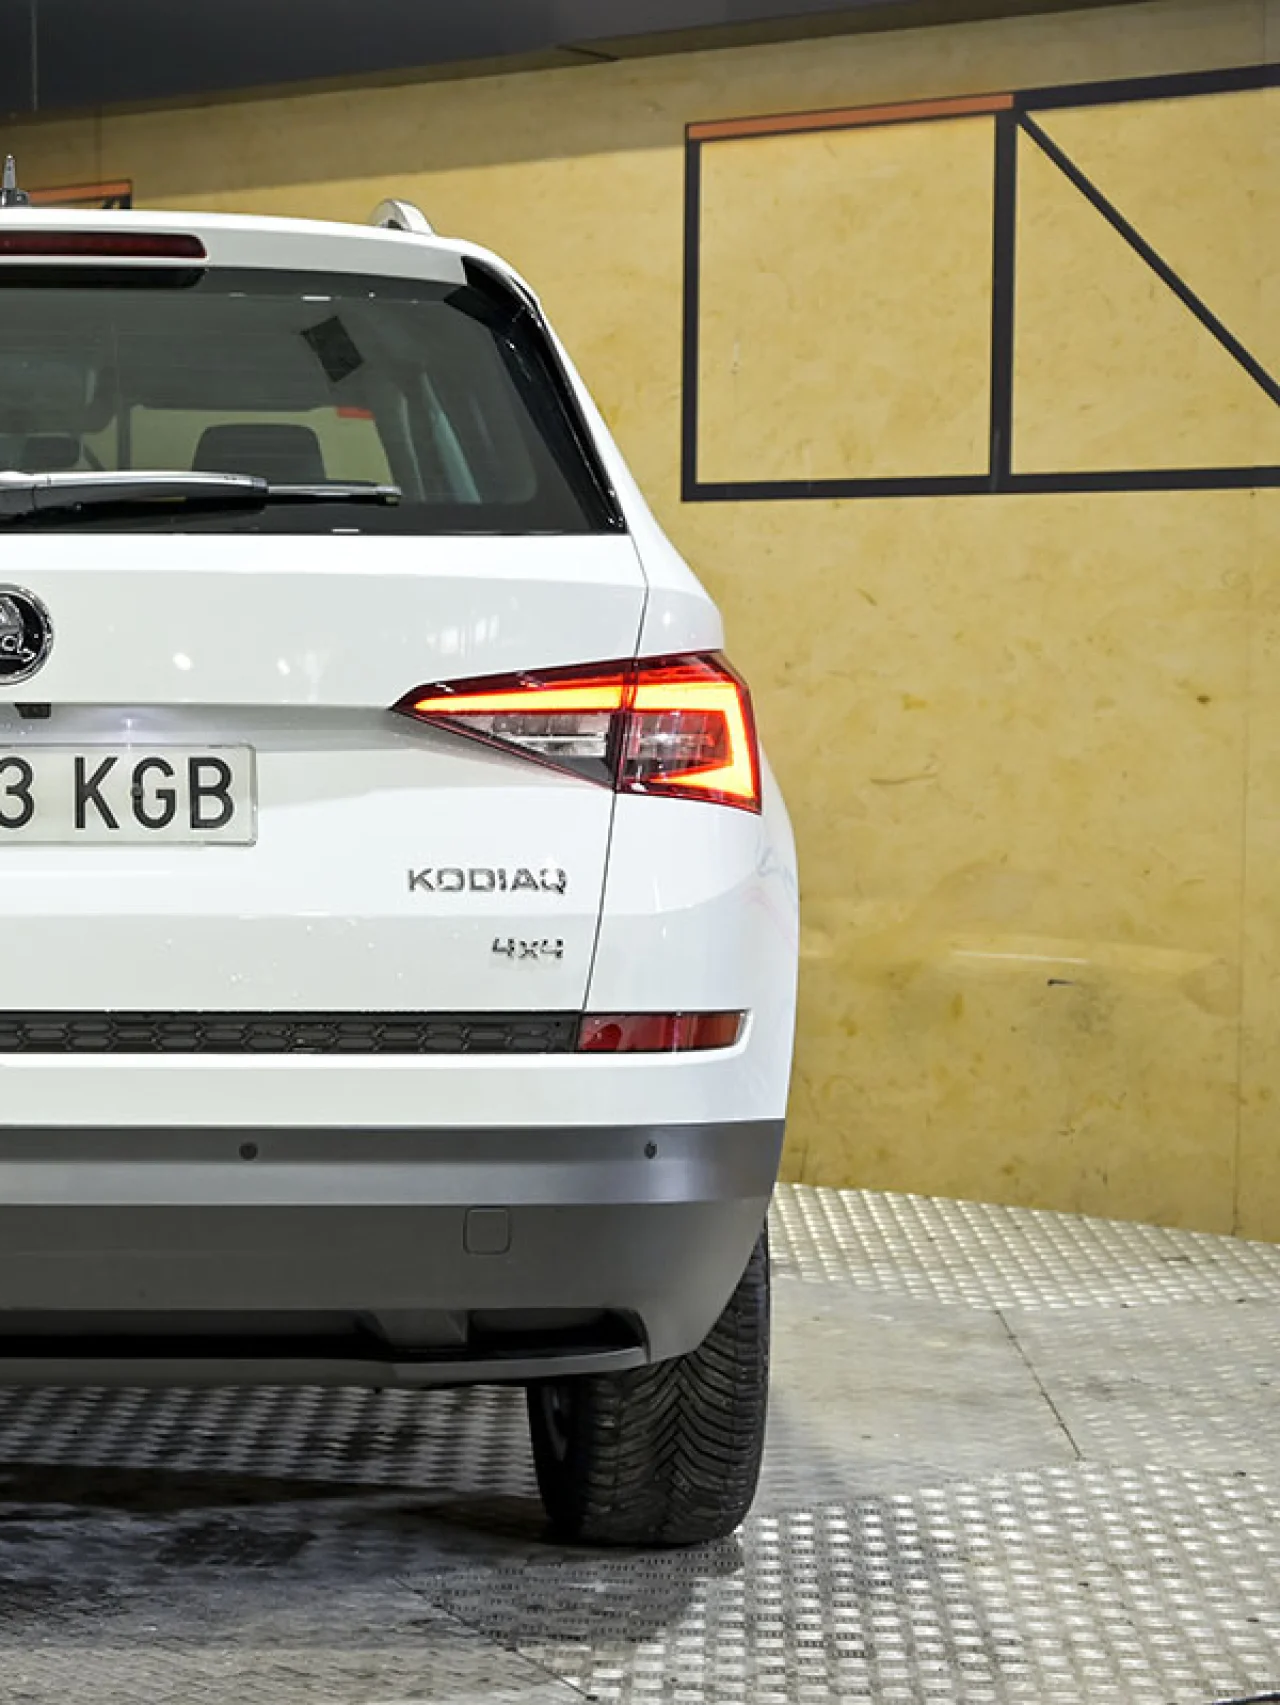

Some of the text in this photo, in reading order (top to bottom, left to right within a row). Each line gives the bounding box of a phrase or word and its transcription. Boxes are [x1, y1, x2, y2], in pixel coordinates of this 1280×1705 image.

[74, 756, 235, 829] KGB
[407, 867, 568, 895] KODIAQ
[491, 938, 565, 959] 4x4
